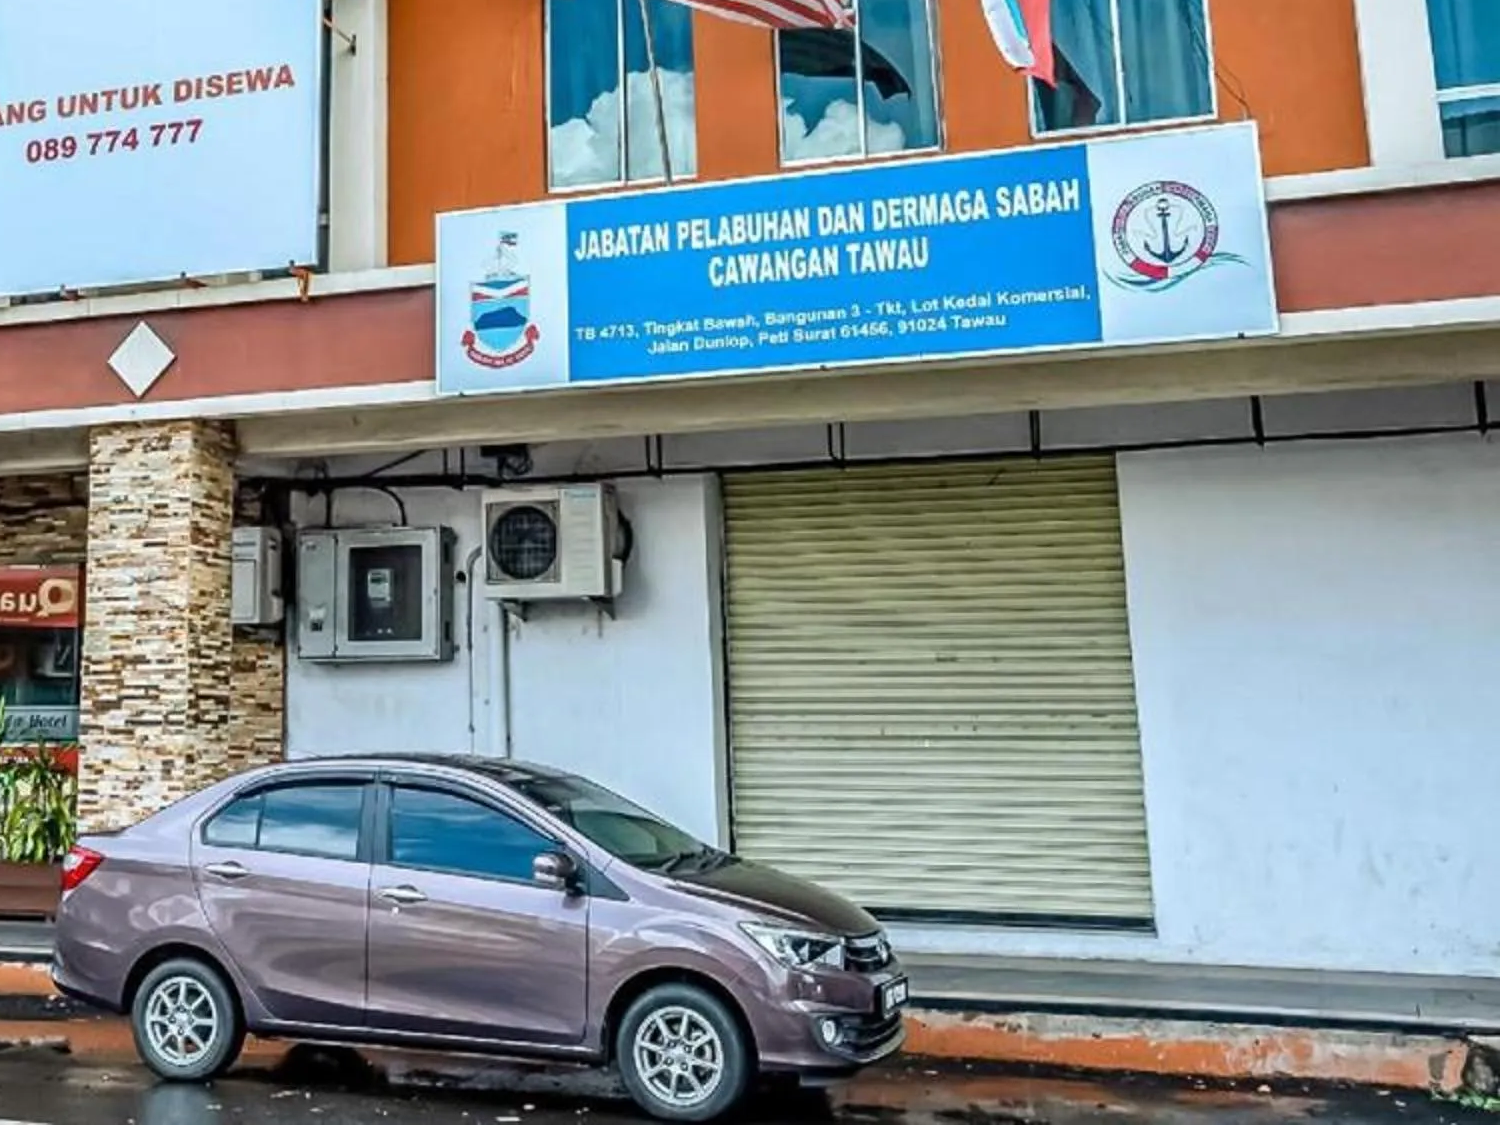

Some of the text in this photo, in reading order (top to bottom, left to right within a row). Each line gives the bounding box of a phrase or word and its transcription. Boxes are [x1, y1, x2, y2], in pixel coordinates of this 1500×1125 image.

[57, 84, 163, 119] UNTUK
[173, 63, 296, 104] DISEWA
[26, 118, 204, 164] 089 774 777
[574, 178, 1081, 261] JABATAN PELABUHAN DAN DERMAGA SABAH
[708, 236, 929, 288] CAWANGAN TAWAU
[575, 327, 597, 340] TB
[643, 317, 699, 337] Tingkat
[704, 313, 761, 332] Bawah,
[765, 307, 847, 328] Bangunan
[851, 304, 861, 317] 3
[911, 298, 940, 313] Lot
[943, 291, 992, 310] Kedai
[997, 284, 1092, 306] Komersial,
[647, 335, 689, 355] Jalan
[694, 333, 755, 352] Dunlop,
[758, 329, 789, 345] Peti
[792, 325, 836, 342] Surat
[897, 317, 947, 334] 91024
[952, 313, 1007, 330] Tawau
